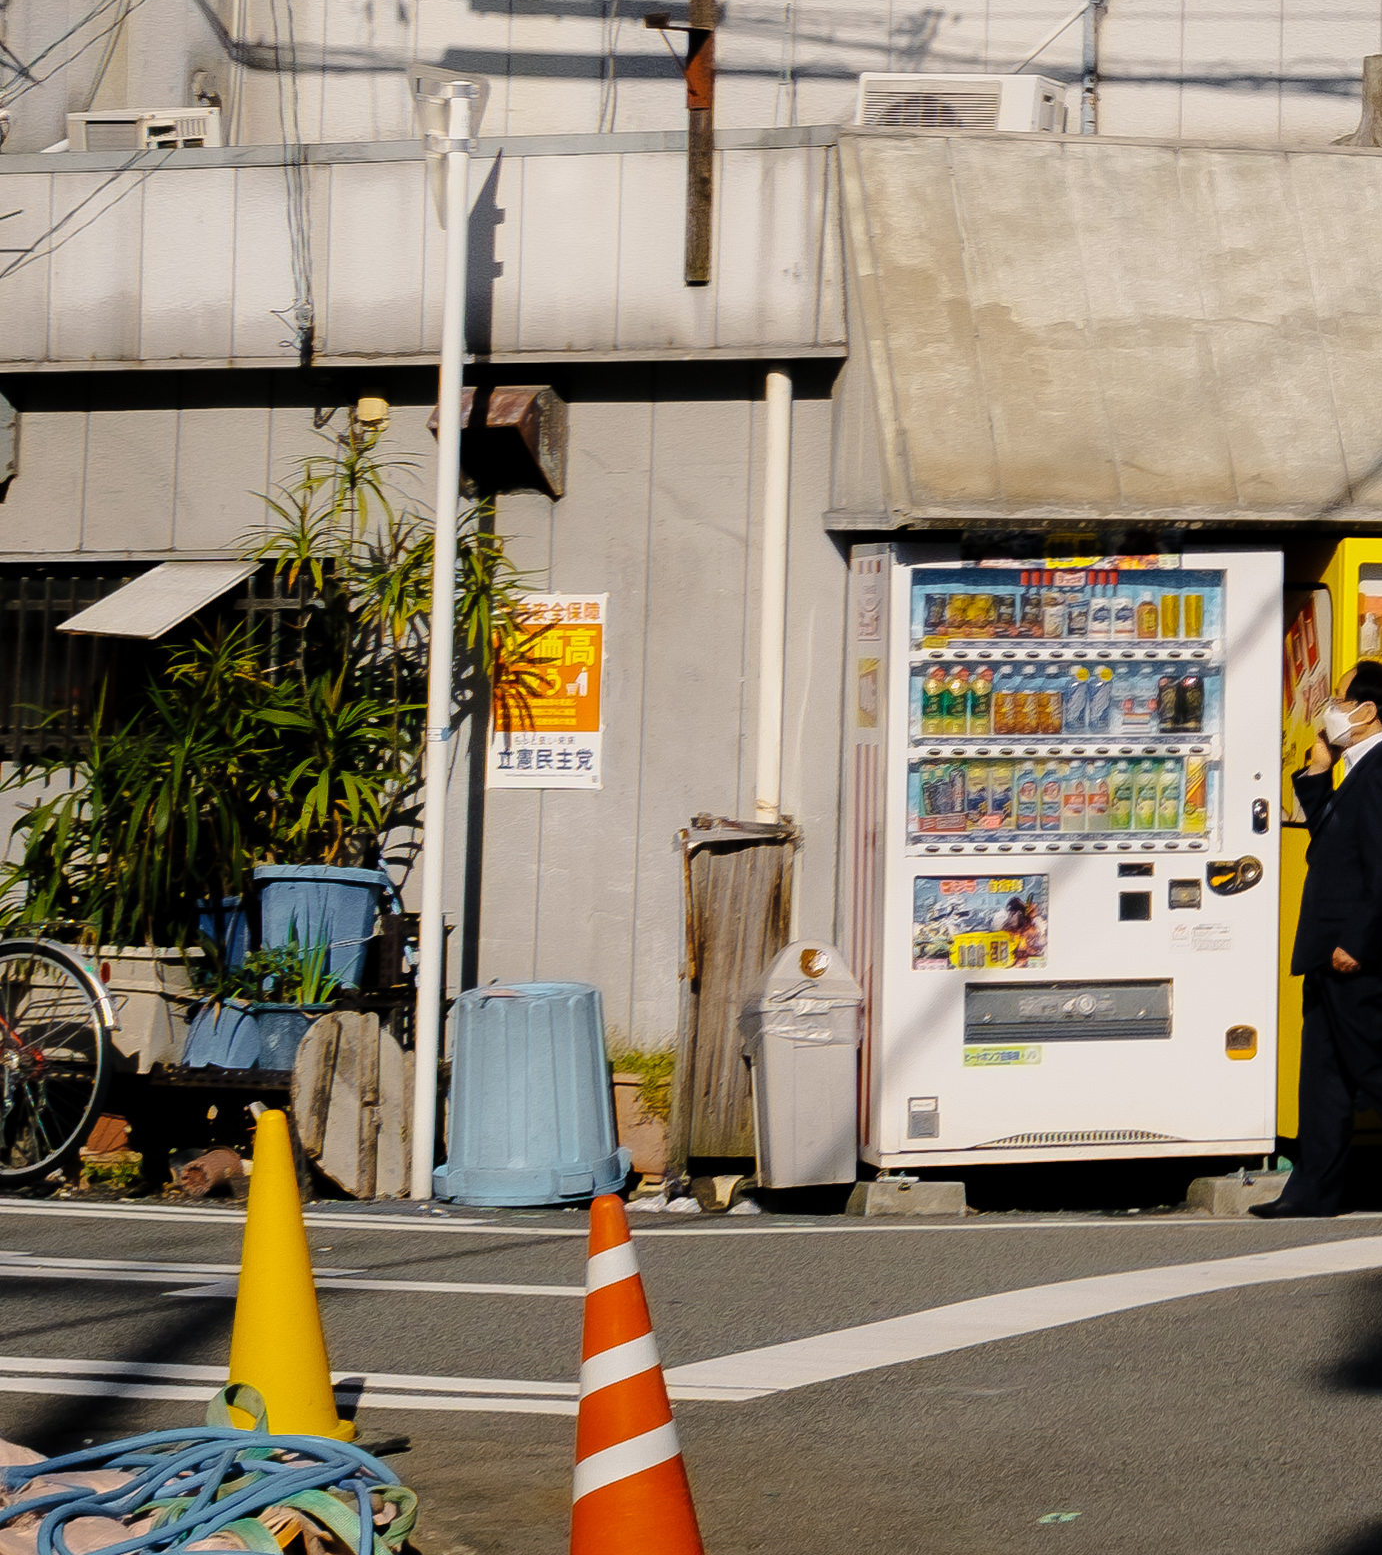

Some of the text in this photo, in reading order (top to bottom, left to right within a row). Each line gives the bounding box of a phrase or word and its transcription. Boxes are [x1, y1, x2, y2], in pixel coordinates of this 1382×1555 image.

[495, 748, 594, 770] 立憲民主党
